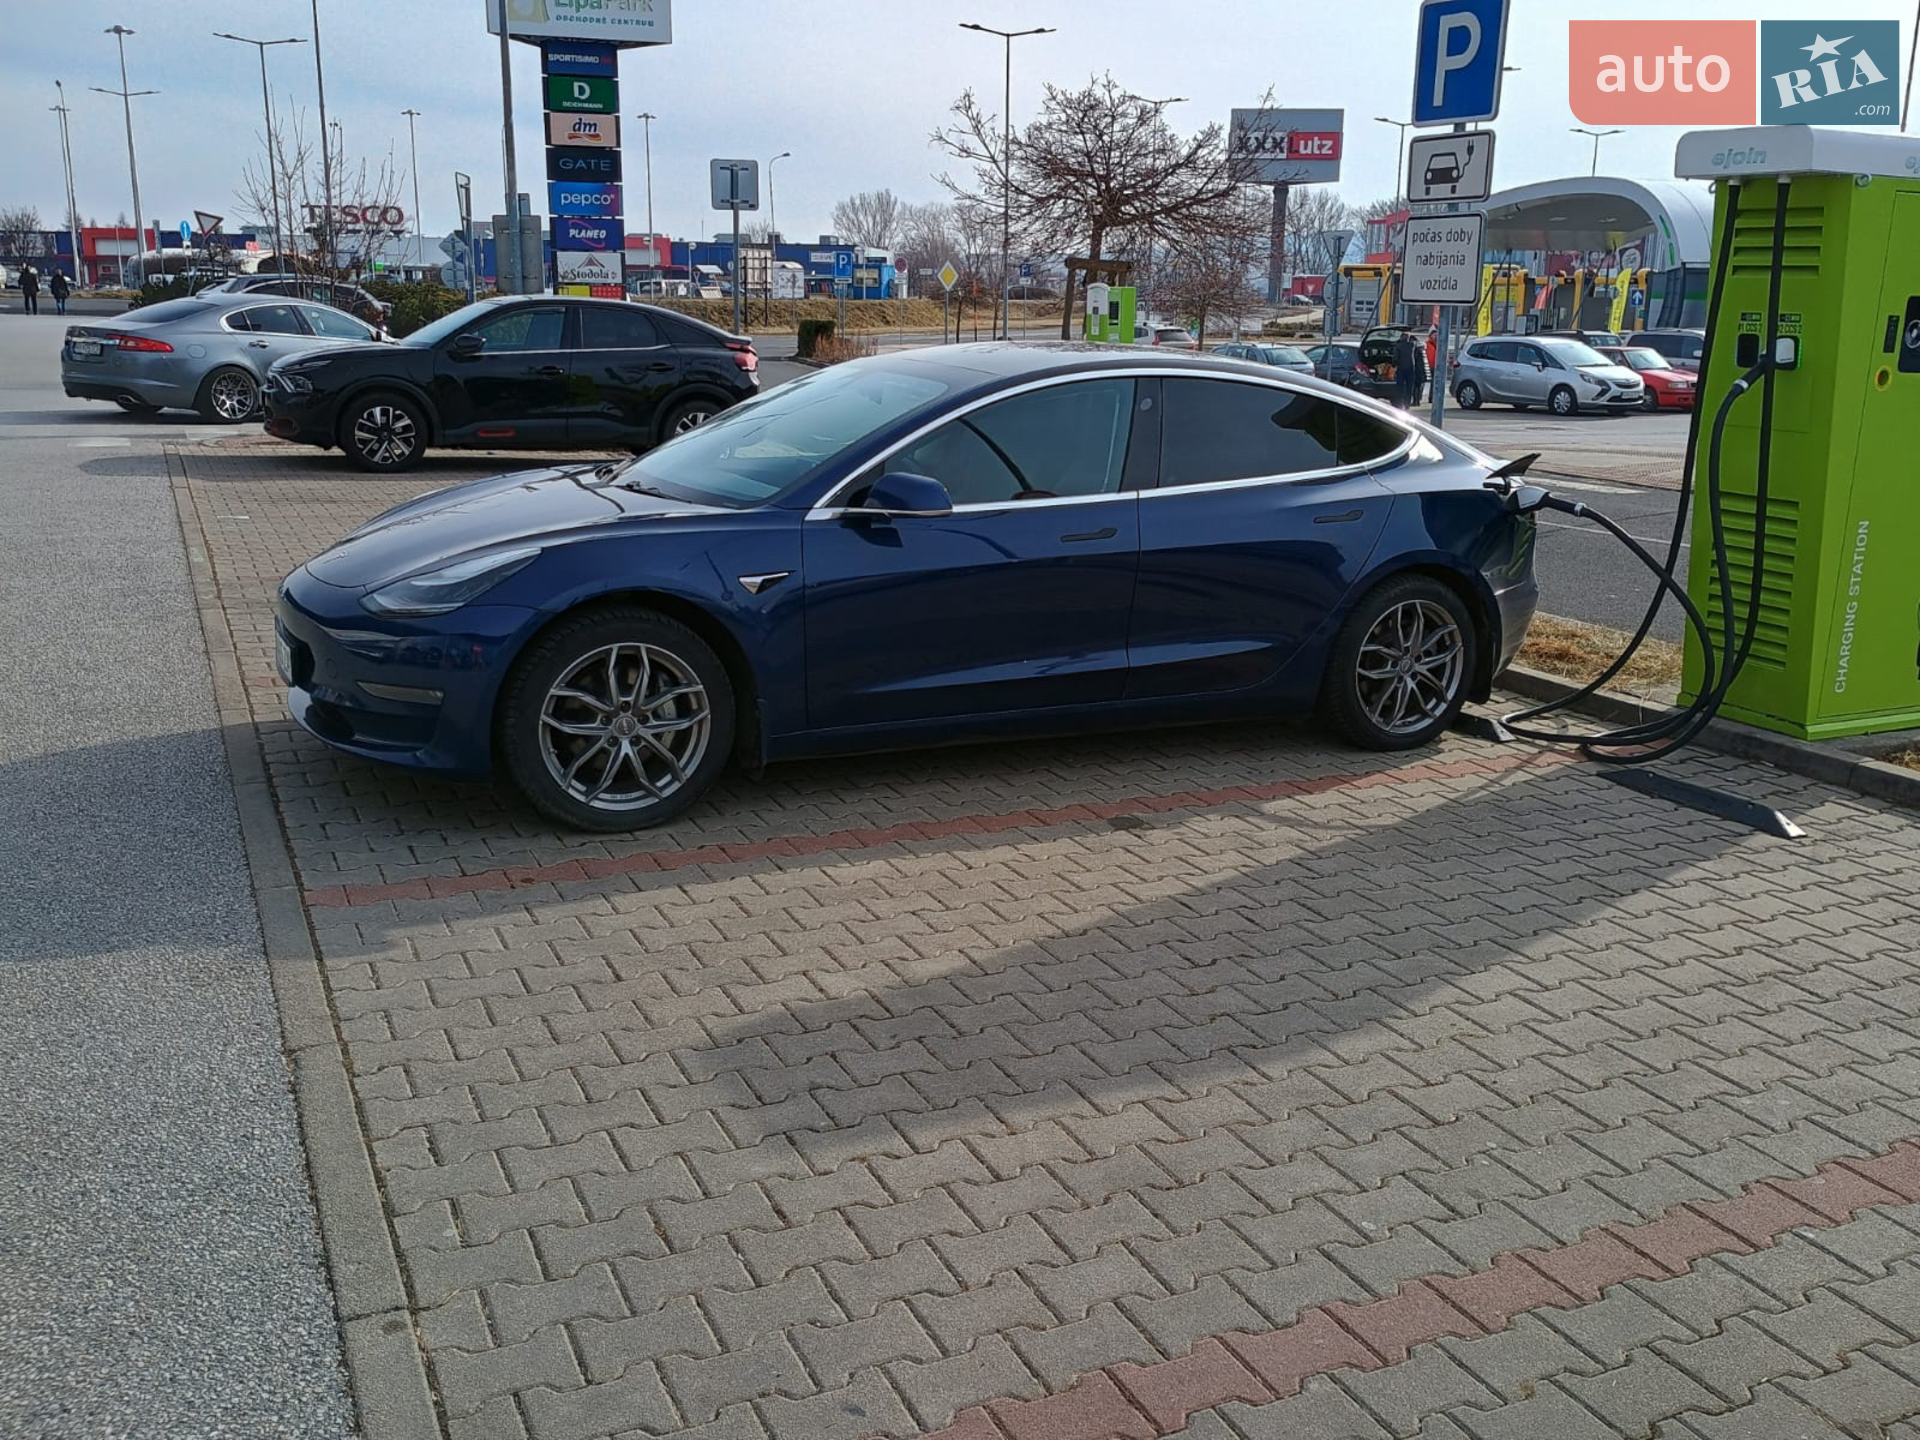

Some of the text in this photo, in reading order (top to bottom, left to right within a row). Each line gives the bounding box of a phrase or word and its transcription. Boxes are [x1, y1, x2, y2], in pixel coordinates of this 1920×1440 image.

[611, 18, 654, 26] CENTRUM
[547, 53, 600, 63] SPORTISIMO
[1433, 11, 1482, 107] P
[573, 81, 591, 100] D
[562, 101, 604, 109] DEICHMANN
[572, 117, 598, 134] dm
[559, 158, 612, 171] GATE
[1711, 147, 1767, 169] ejoin
[561, 193, 611, 207] pepco
[300, 204, 404, 226] TESCO
[569, 228, 606, 239] PLANEO
[1412, 227, 1473, 246] počas doby
[570, 268, 609, 280] Stodola
[1420, 275, 1458, 290] vozidla
[1835, 520, 1869, 693] CHARGING STATION
